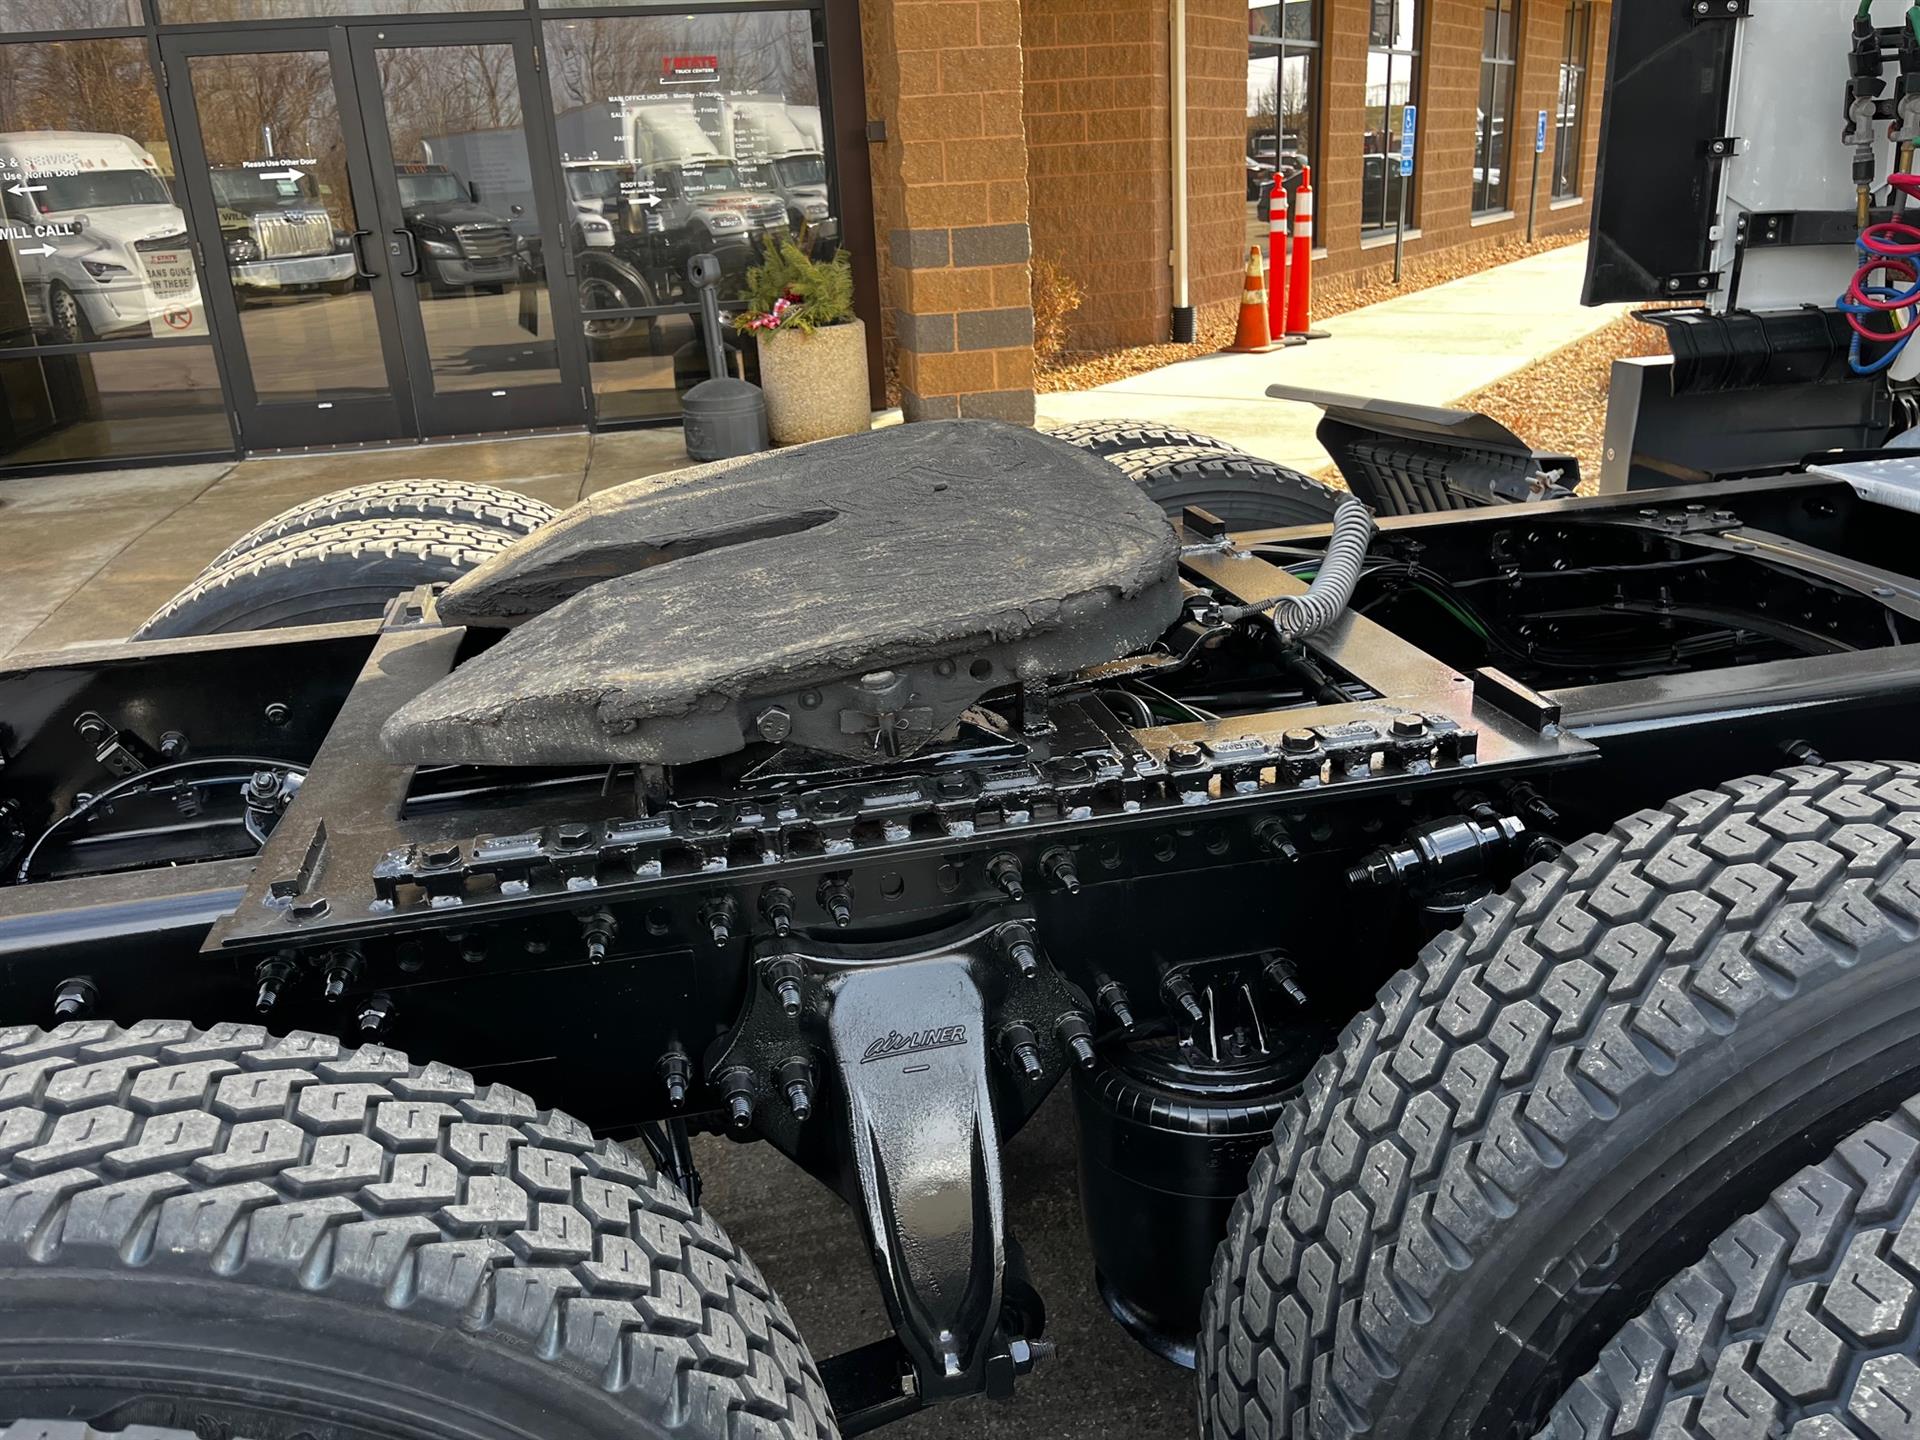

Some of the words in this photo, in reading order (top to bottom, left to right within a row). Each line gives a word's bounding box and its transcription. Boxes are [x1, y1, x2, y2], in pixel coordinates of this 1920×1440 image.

[625, 94, 647, 102] OFFICE
[647, 93, 668, 101] HOURS
[10, 157, 18, 168] &
[242, 160, 265, 168] Please
[280, 158, 299, 166] Other
[3, 172, 22, 180] Use
[26, 170, 53, 179] North
[56, 169, 79, 177] Door
[35, 223, 74, 237] CALL
[169, 267, 192, 277] GUNS
[163, 278, 190, 288] THESE
